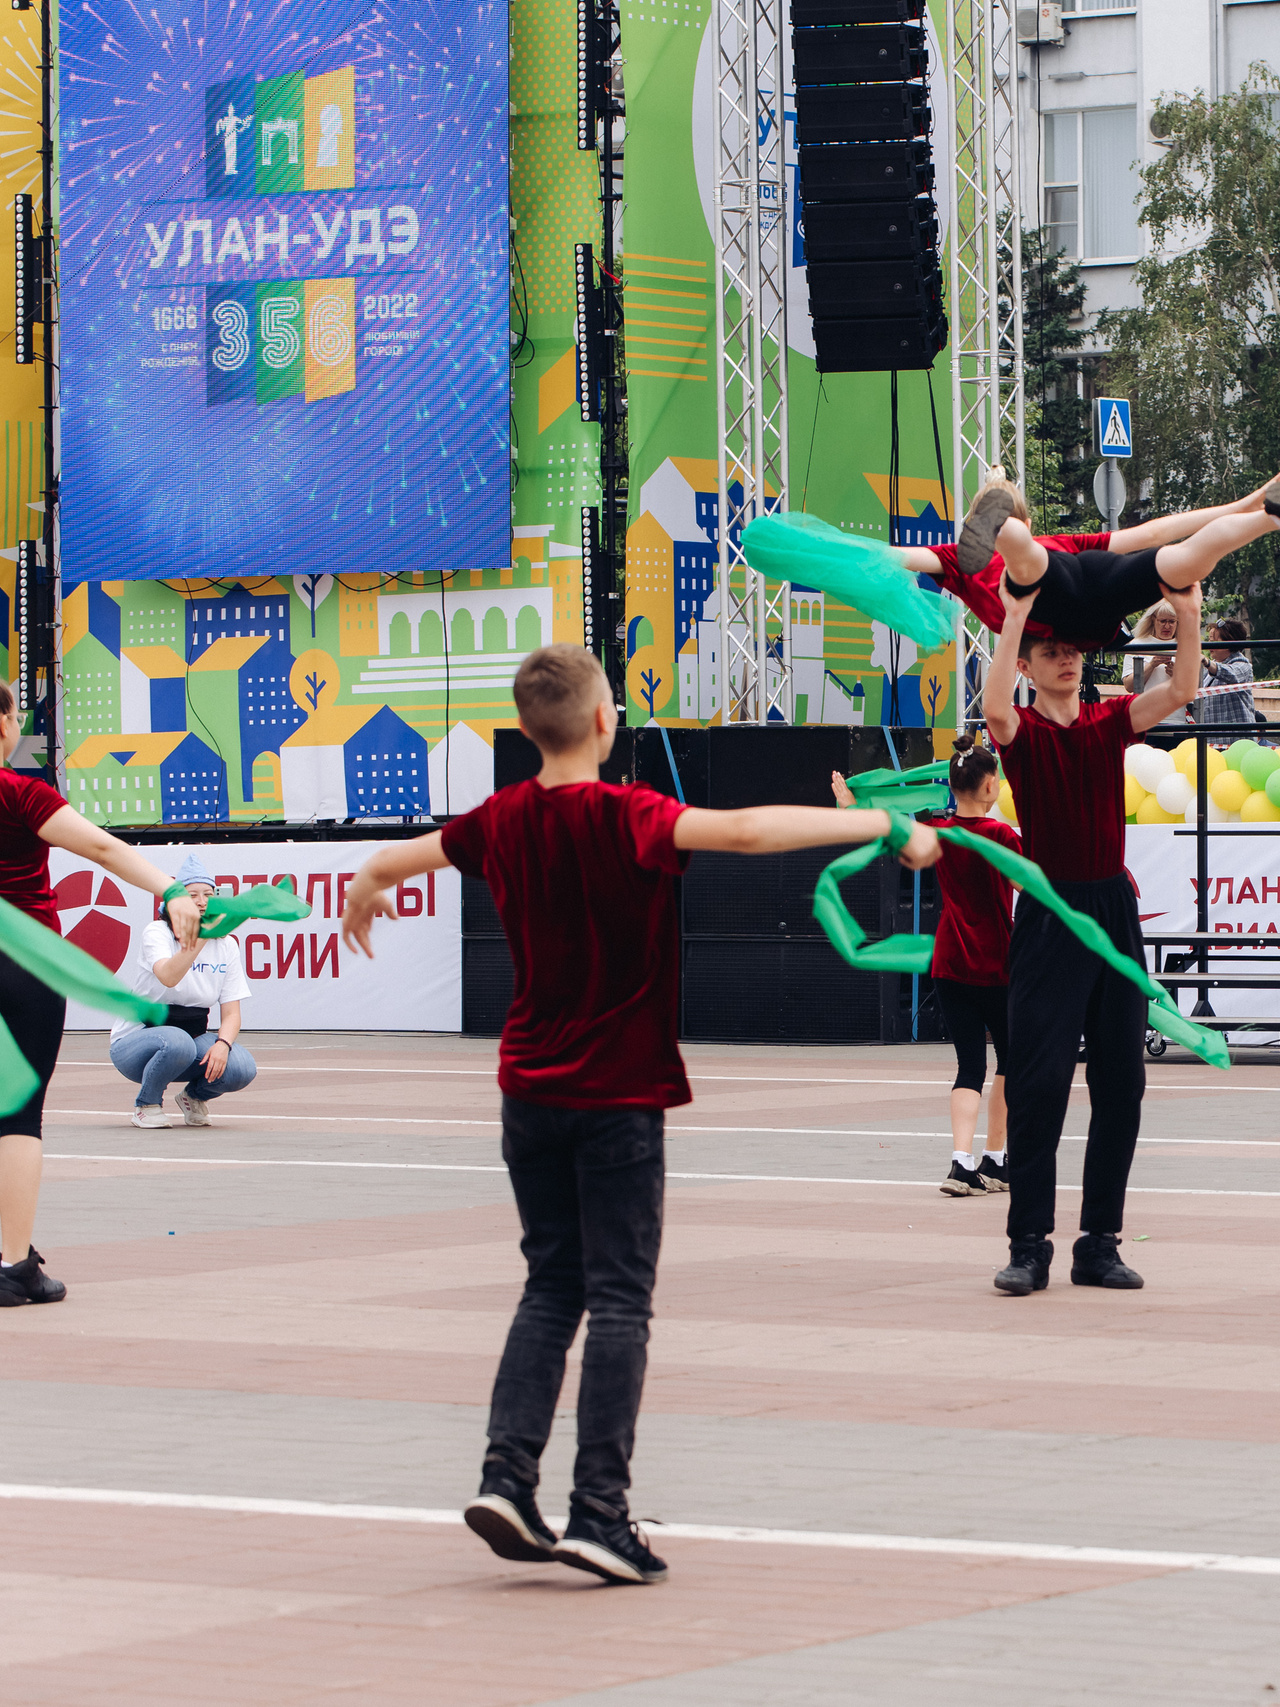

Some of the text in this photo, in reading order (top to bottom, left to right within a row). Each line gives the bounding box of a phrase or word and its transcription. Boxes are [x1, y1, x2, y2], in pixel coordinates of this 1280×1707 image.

[145, 205, 420, 269] УЛАН-УДЭ
[151, 305, 197, 331] 1666
[363, 293, 419, 320] 2022
[212, 294, 351, 371] 356
[191, 961, 227, 974] ИГУС
